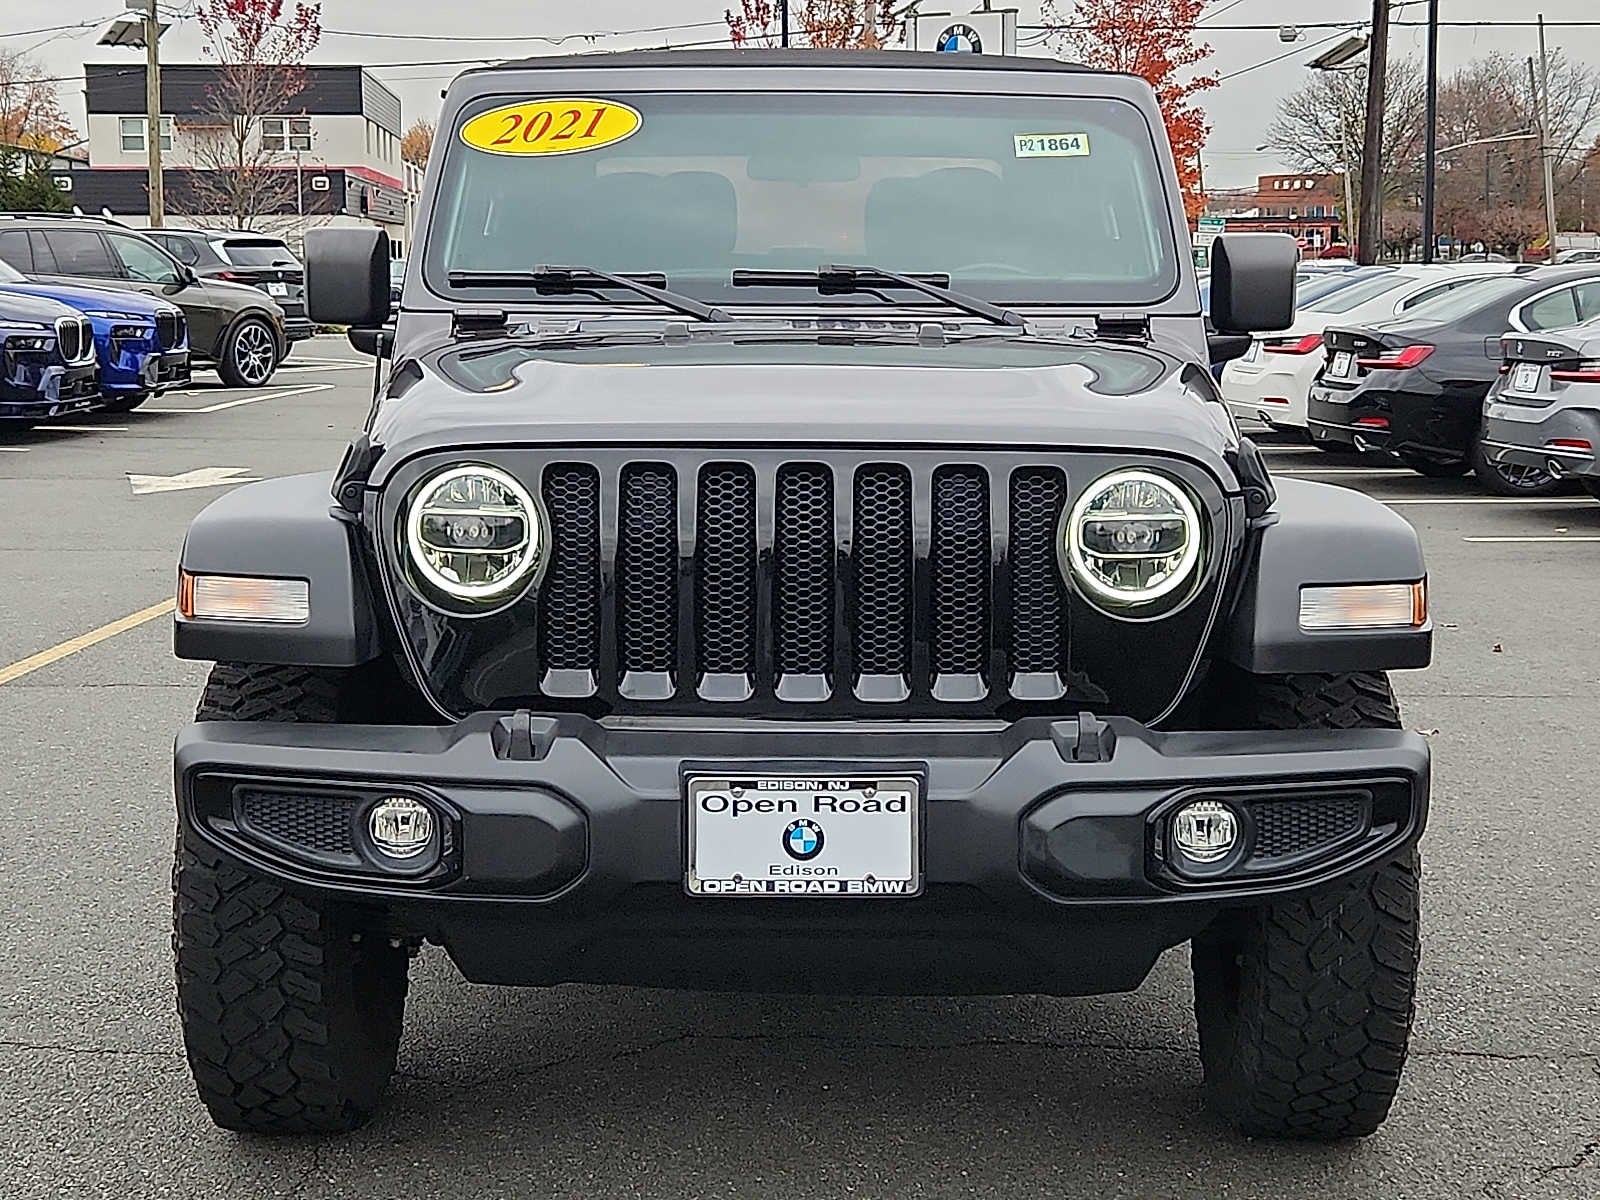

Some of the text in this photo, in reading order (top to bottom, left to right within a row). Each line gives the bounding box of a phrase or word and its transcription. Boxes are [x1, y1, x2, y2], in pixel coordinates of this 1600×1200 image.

[940, 25, 979, 44] BMW
[490, 106, 607, 146] 2021
[828, 781, 850, 790] NJ
[701, 795, 906, 817] Open Road
[788, 819, 821, 832] BMW
[769, 864, 838, 876] Edison
[703, 880, 905, 893] OPEN ROAD BMW
